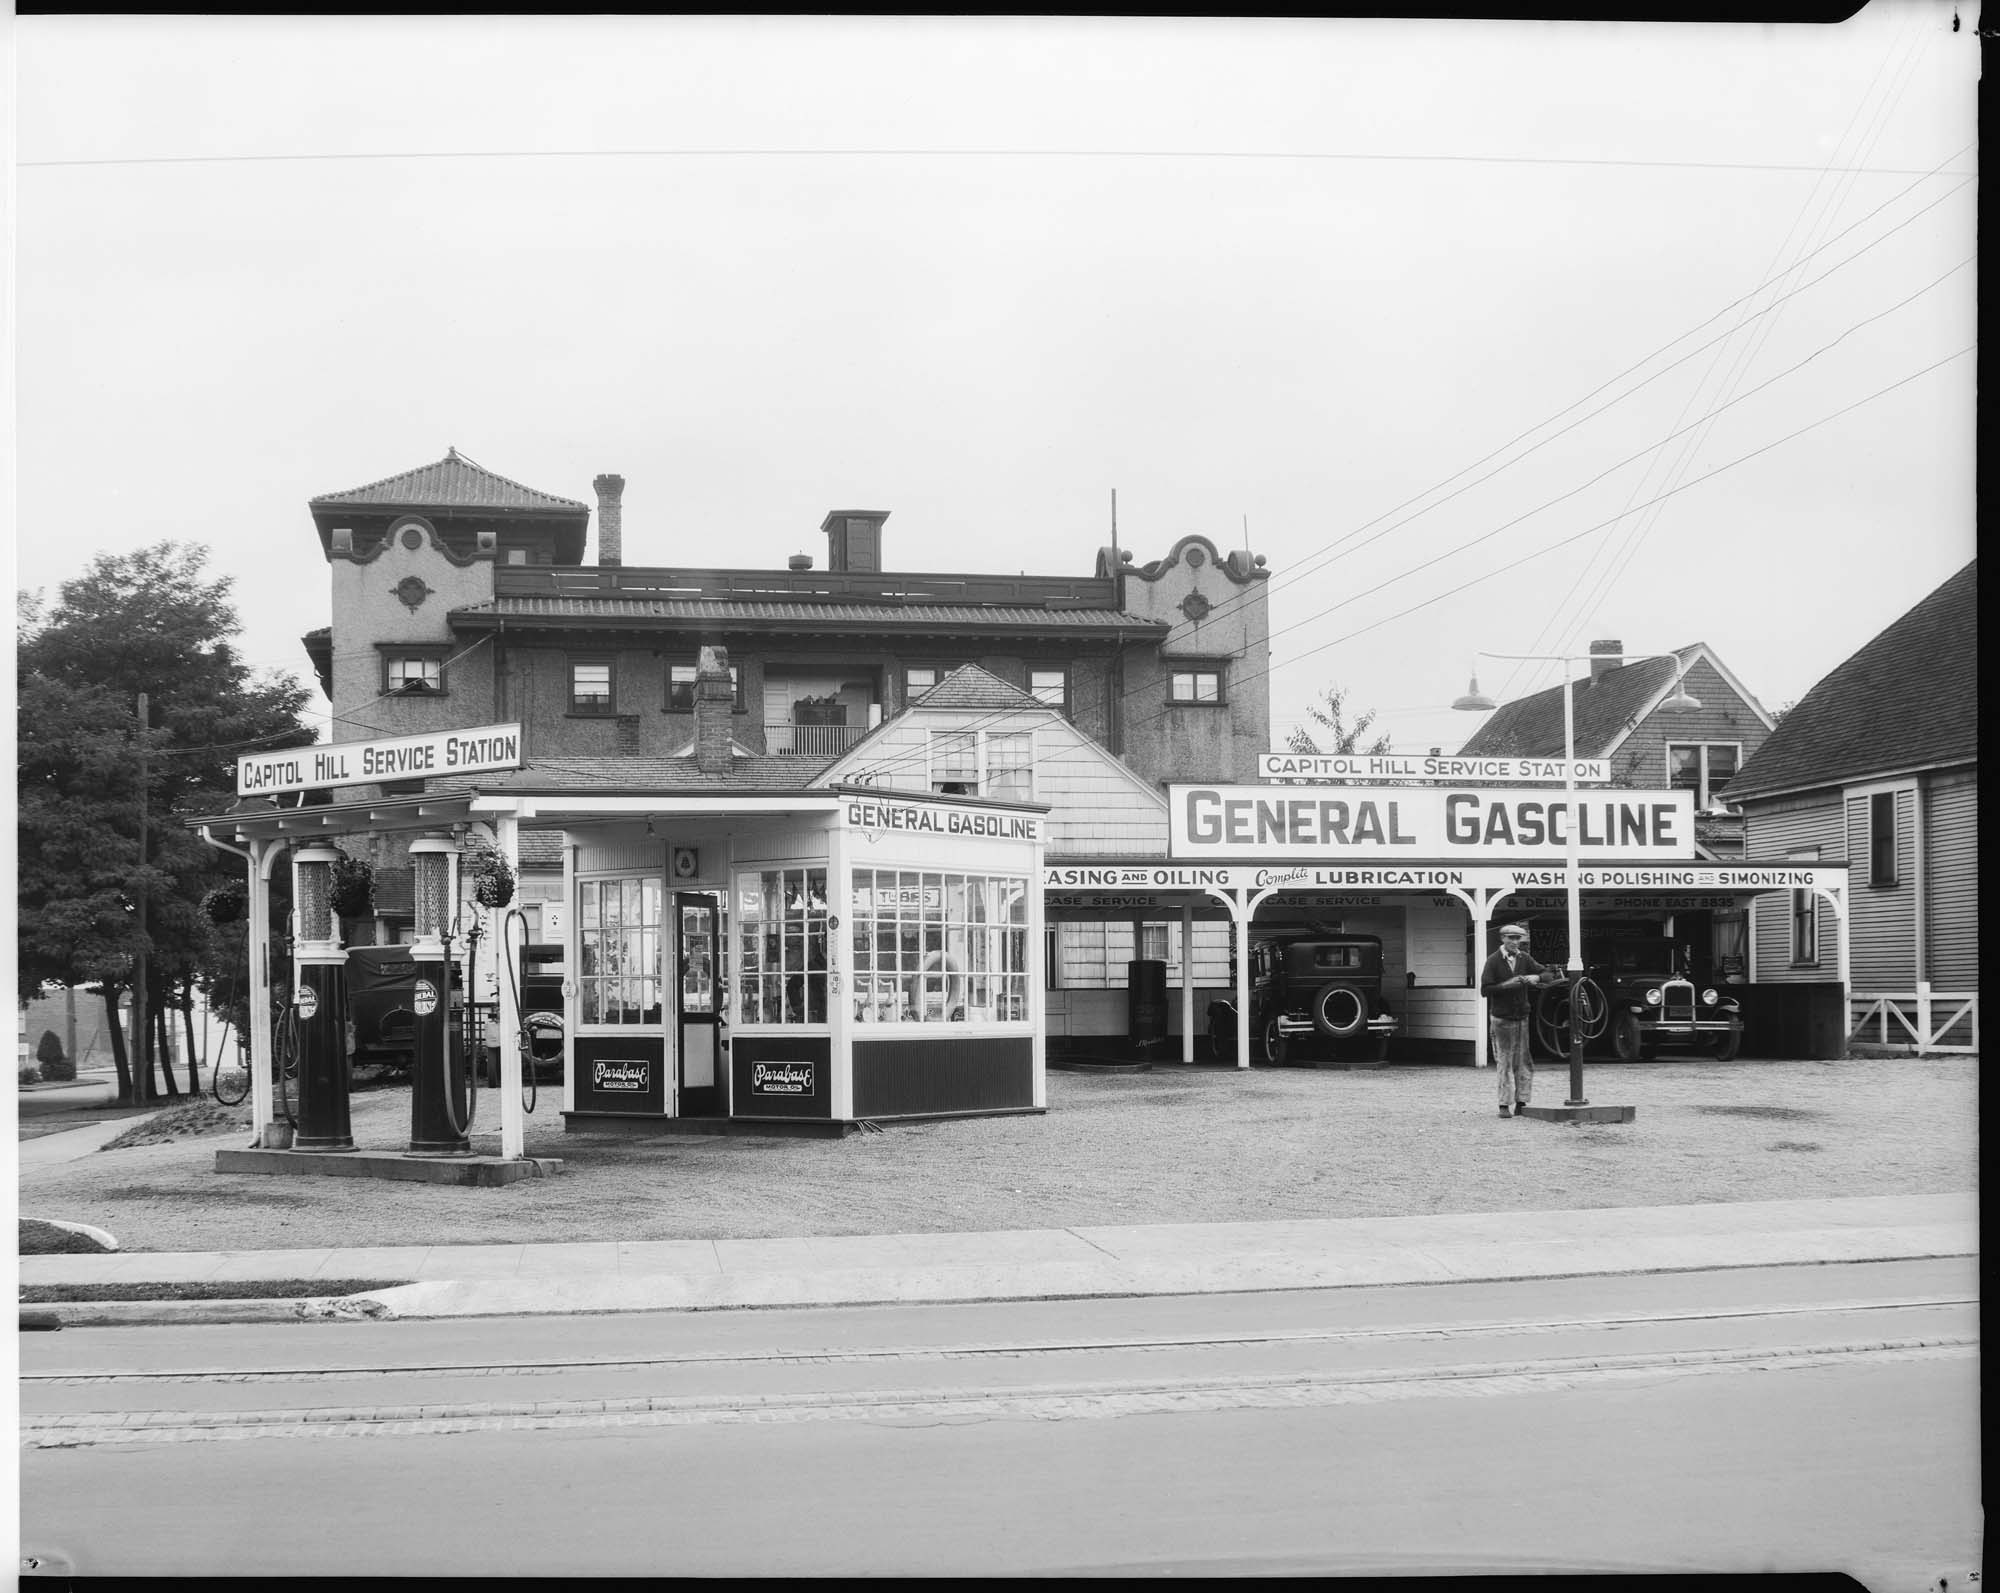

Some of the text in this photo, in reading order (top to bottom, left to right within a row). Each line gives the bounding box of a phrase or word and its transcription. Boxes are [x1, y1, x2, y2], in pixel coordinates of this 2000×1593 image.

[244, 735, 516, 788] CAPITOL HILL SERVICE STATION
[1266, 757, 1601, 777] CAPITOL HILL SERVICE STATON
[848, 804, 1037, 839] GENERAL GASOLINE
[1186, 790, 1678, 846] GENERAL GASOLINE
[1044, 870, 1229, 885] ASING AND OILING
[1255, 867, 1463, 887] Complete LUBRICATION
[1512, 872, 1595, 885] WASHG
[1602, 872, 1694, 885] POLISHING
[1719, 872, 1814, 885] SIMONIZING
[1092, 896, 1157, 906] SERVICE
[1316, 896, 1382, 905] SERVICE
[1433, 897, 1455, 907] WE
[1526, 898, 1586, 907] DELIVR
